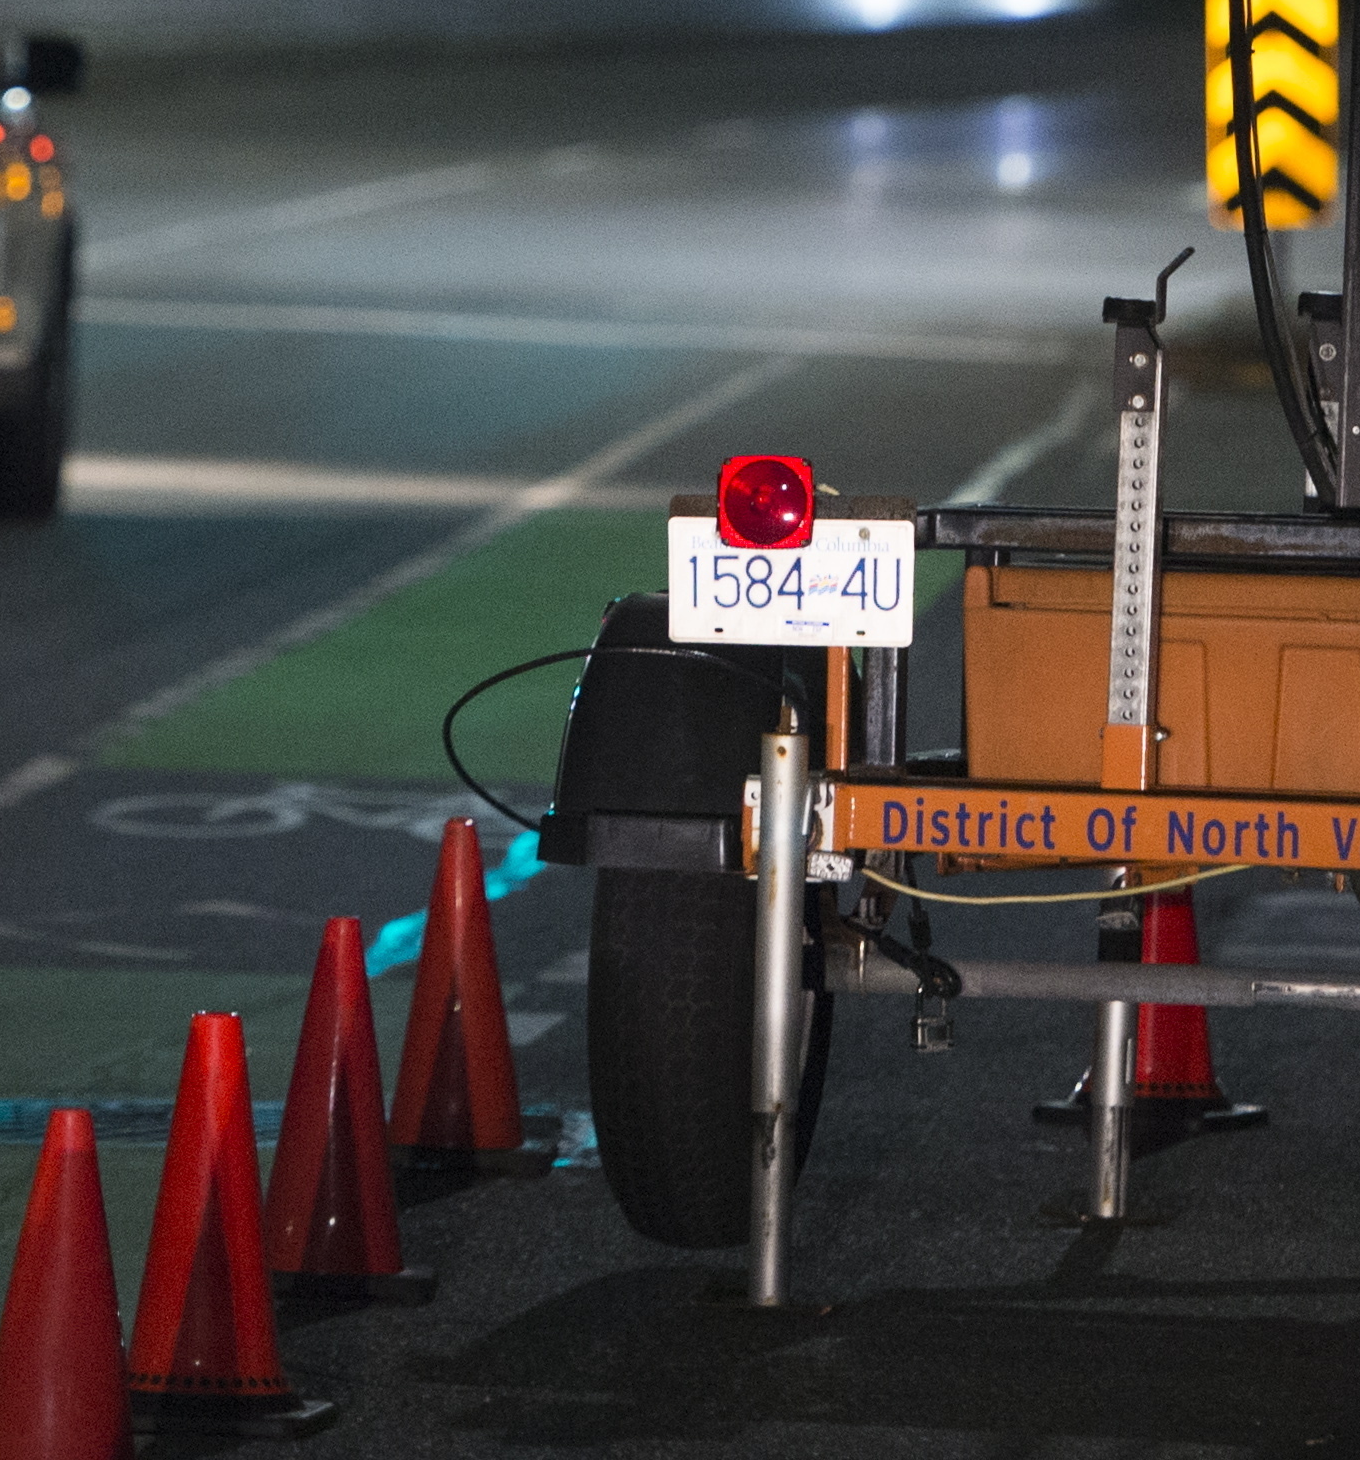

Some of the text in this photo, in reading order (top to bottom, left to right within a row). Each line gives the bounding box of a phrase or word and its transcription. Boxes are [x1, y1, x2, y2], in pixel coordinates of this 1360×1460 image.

[815, 537, 890, 553] Columbia
[689, 554, 901, 612] 1584 4U
[881, 799, 1056, 850] District
[1086, 807, 1138, 853] Of
[1167, 811, 1301, 860] North
